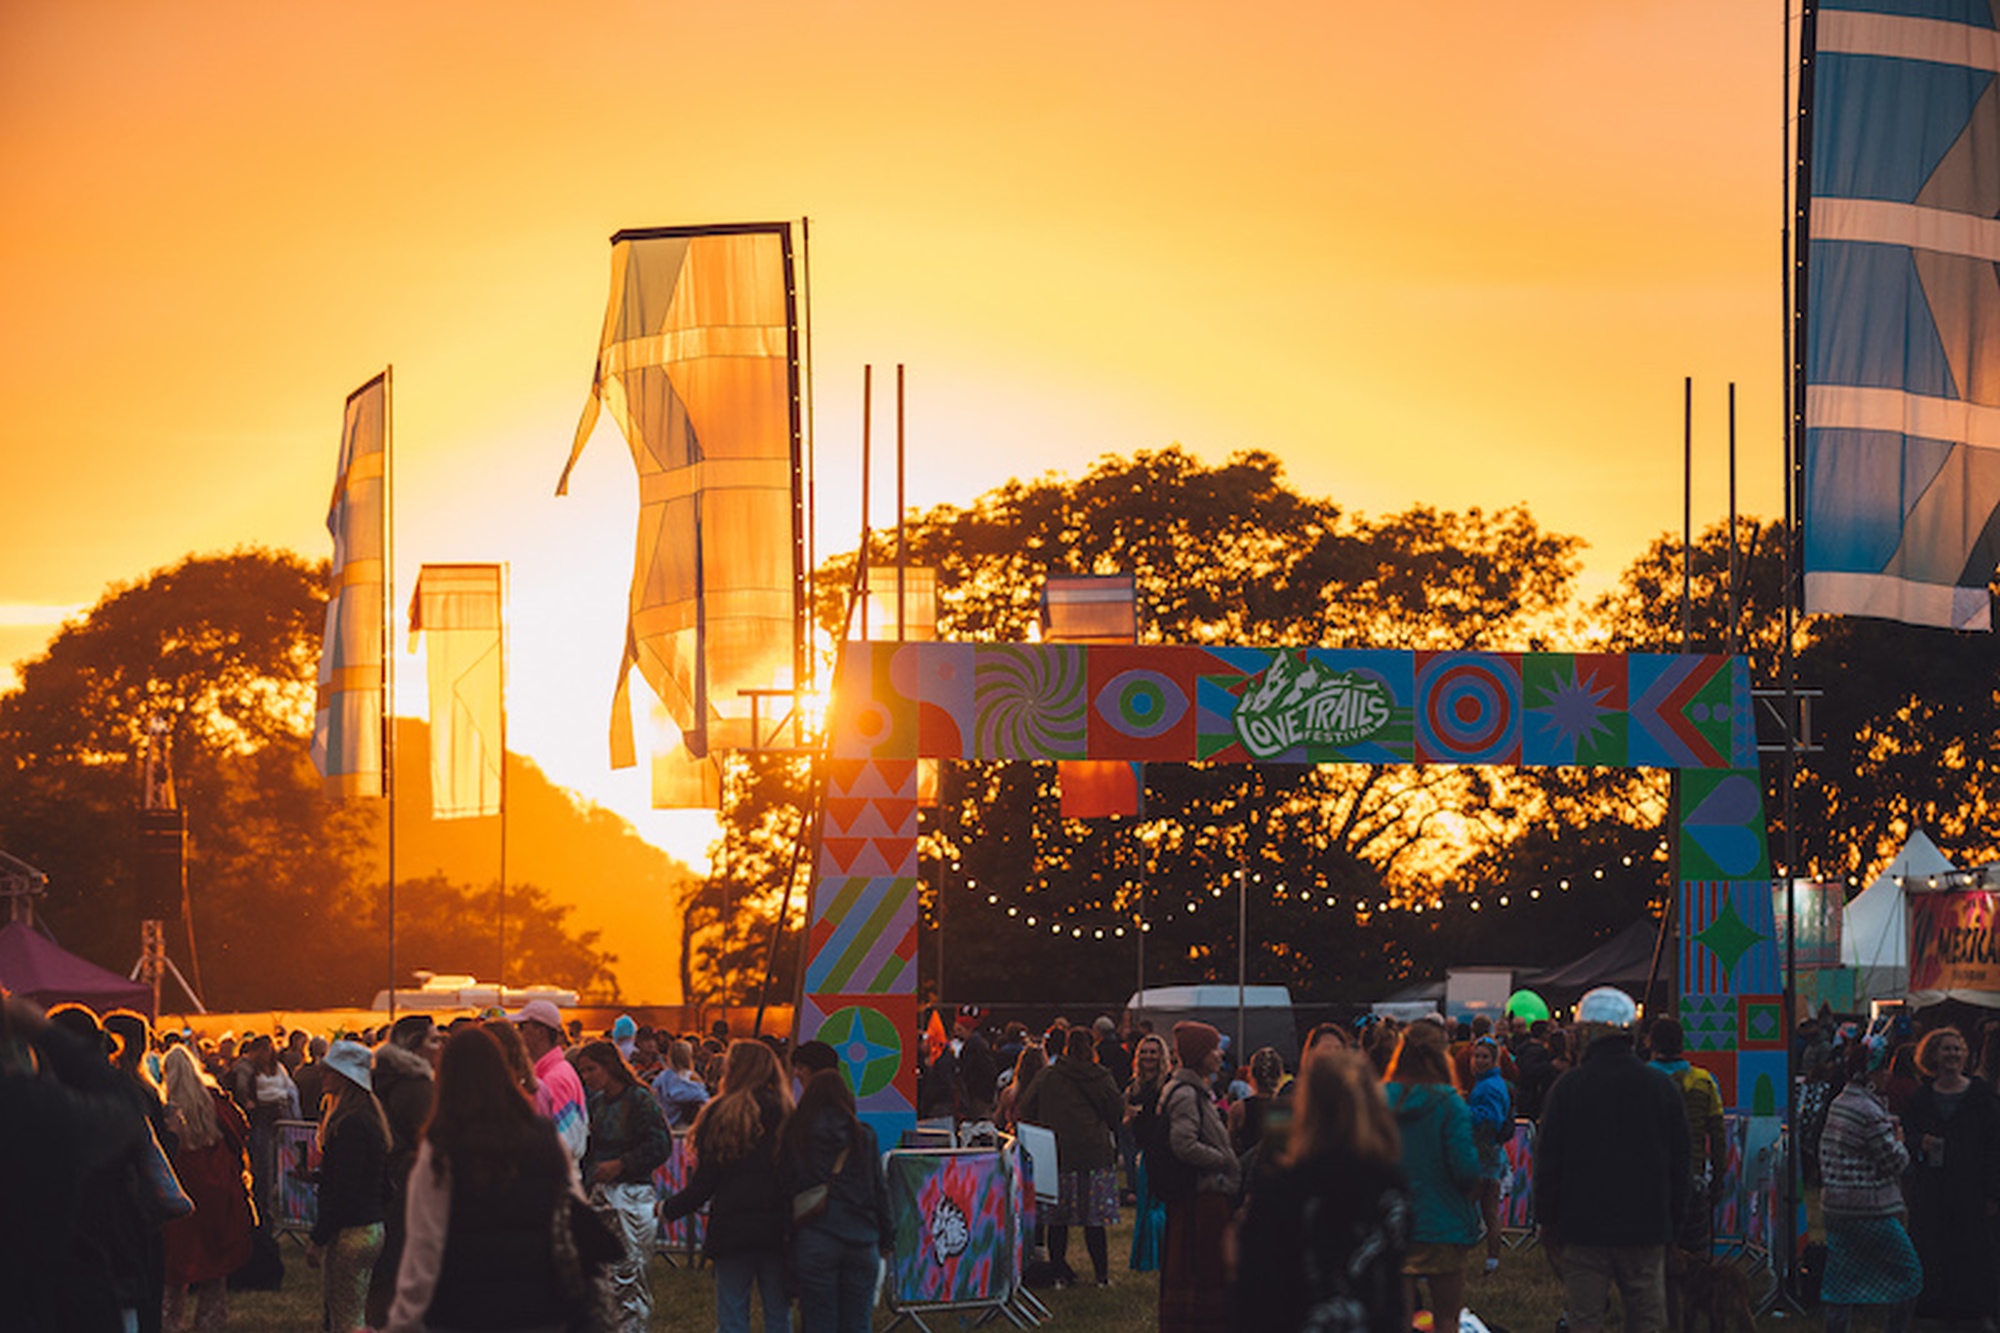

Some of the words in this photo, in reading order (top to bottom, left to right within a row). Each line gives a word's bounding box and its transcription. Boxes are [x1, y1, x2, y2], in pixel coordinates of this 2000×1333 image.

[1236, 708, 1303, 756] LOVE
[1298, 688, 1389, 731] TRAILS
[1304, 725, 1376, 743] FESTIVAL
